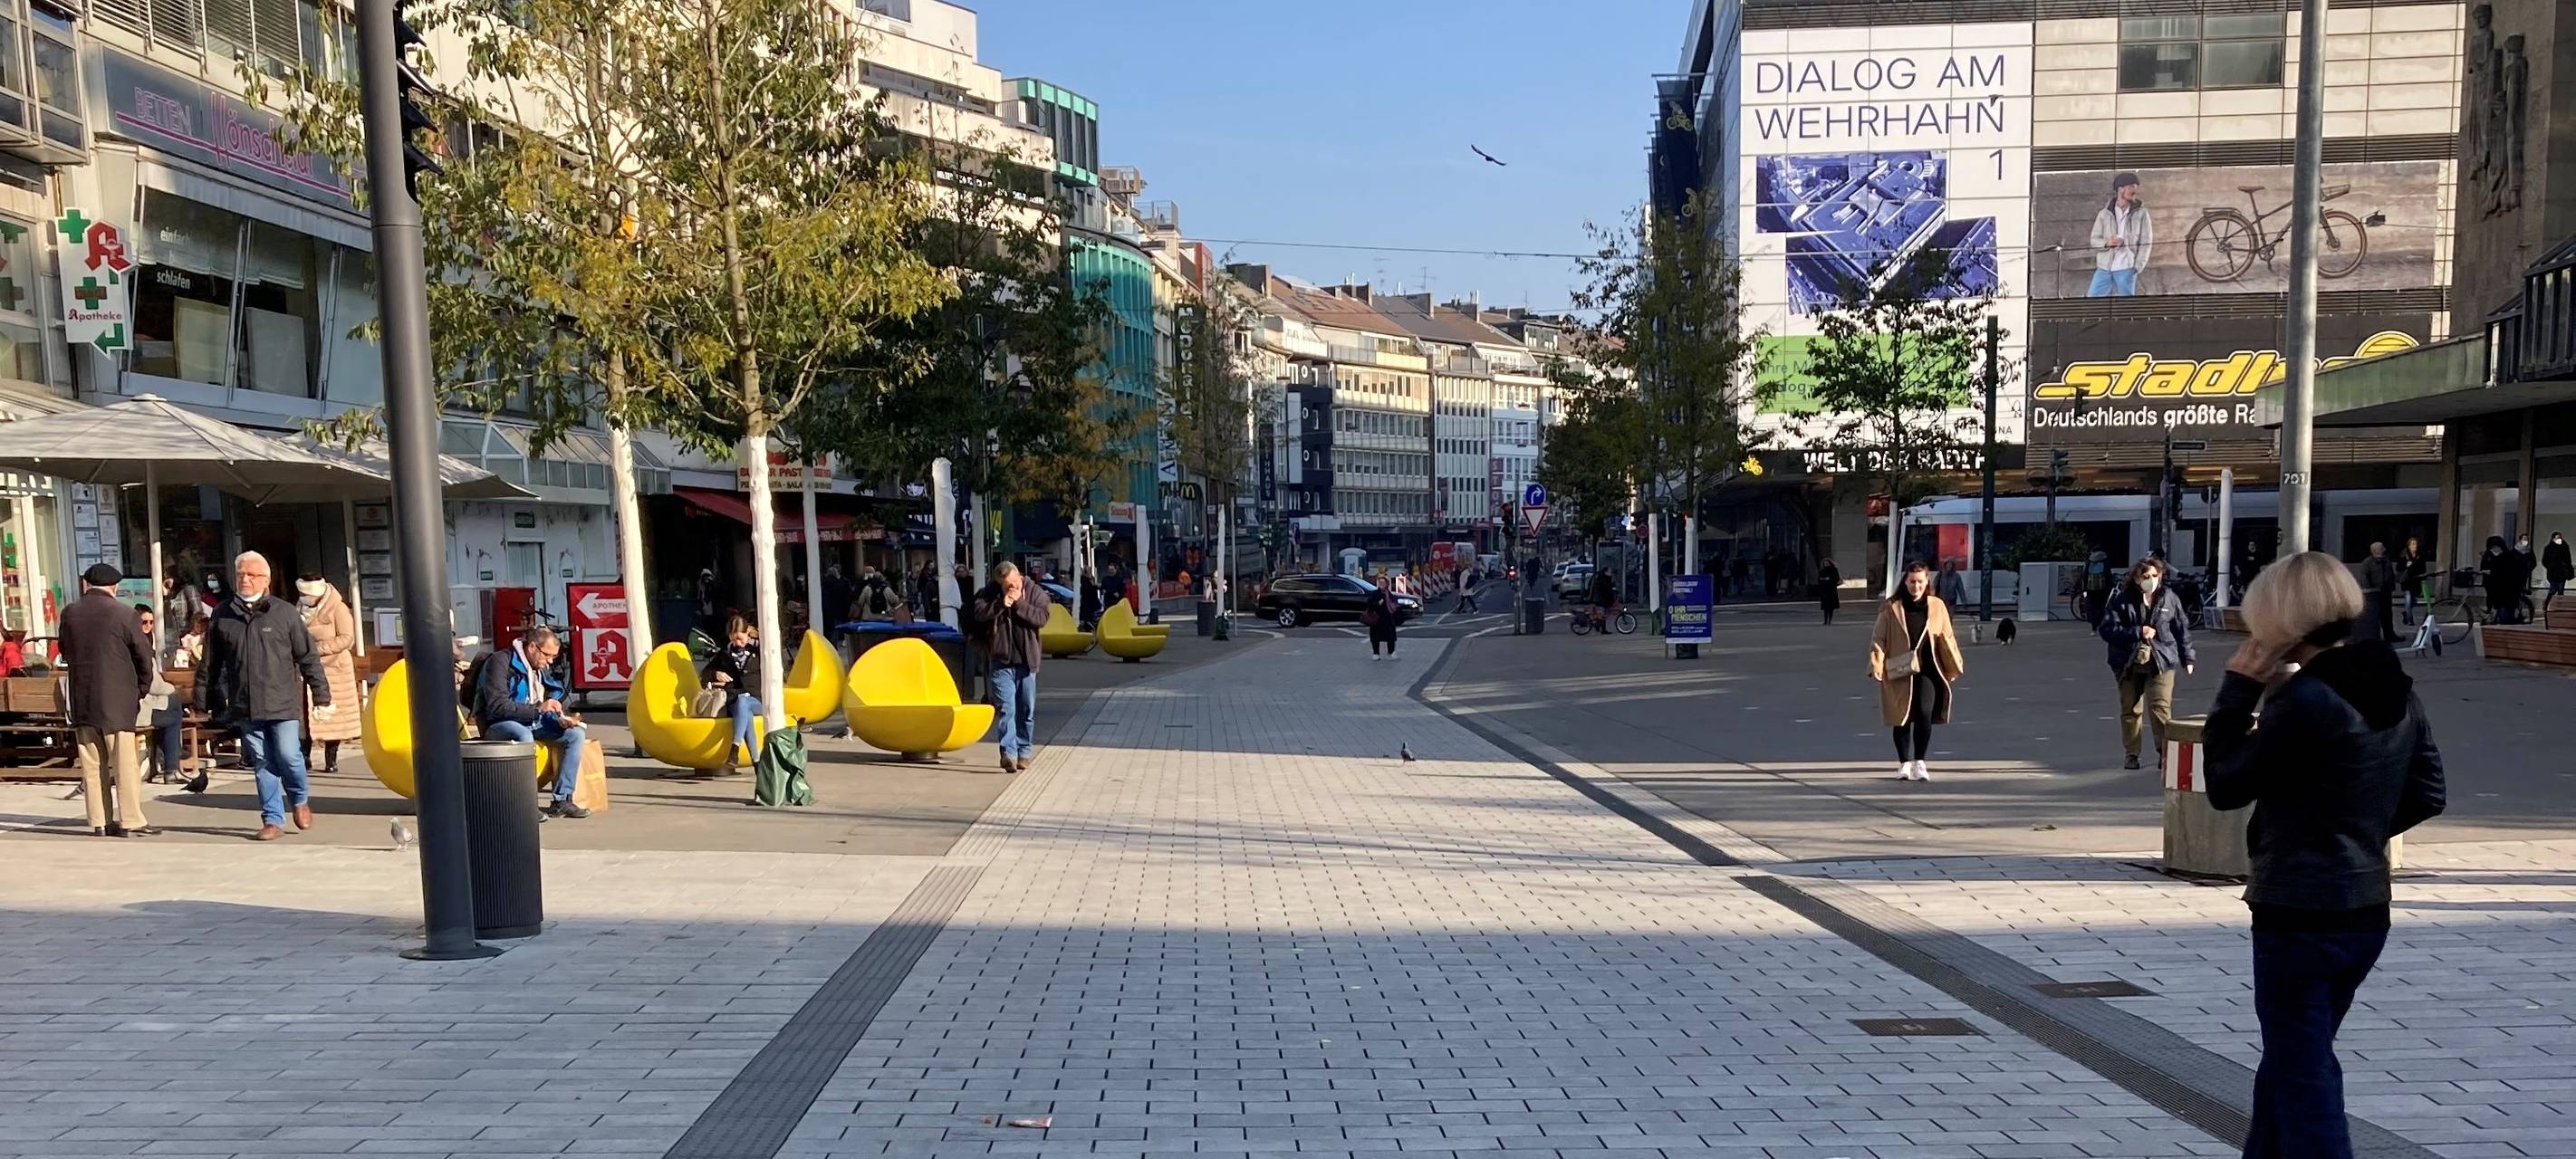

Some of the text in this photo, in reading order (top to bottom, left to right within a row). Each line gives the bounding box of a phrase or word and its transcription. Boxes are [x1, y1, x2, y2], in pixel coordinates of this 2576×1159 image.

[1756, 54, 2004, 93] DIALOG AM
[135, 87, 192, 136] BETTEN
[1755, 101, 2004, 139] WEHRHAHN
[1989, 148, 2003, 181] 1
[156, 269, 191, 290] schlafen
[68, 308, 122, 322] Apotheke
[2033, 406, 2158, 427] Deutschlands
[2163, 403, 2228, 429] größte
[2283, 473, 2306, 484] 701
